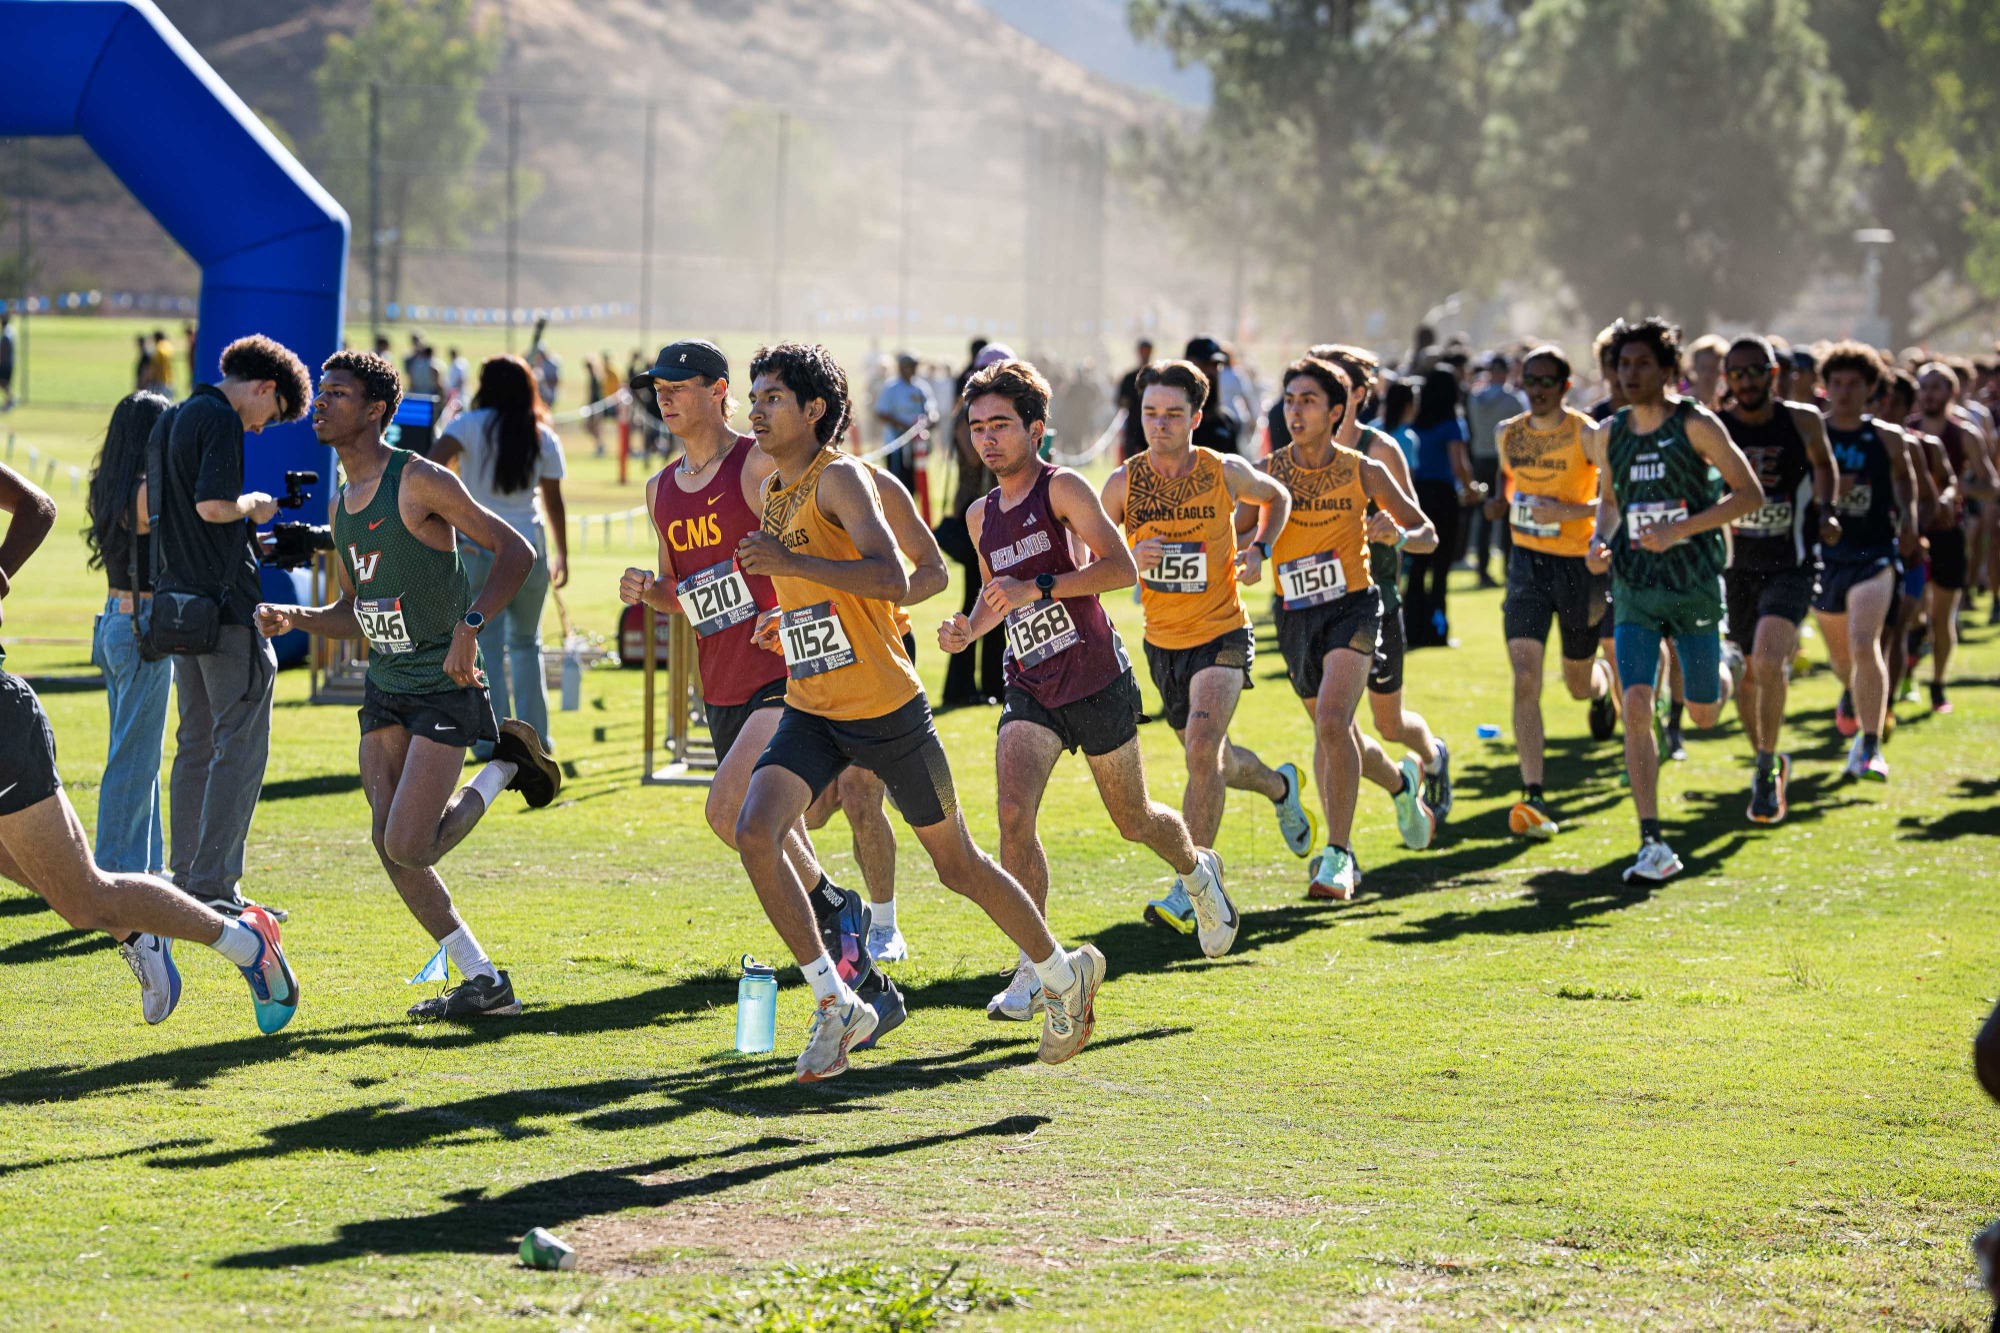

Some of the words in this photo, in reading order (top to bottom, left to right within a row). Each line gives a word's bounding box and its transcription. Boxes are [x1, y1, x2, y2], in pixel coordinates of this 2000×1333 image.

[1629, 462, 1665, 482] HILLS
[1176, 506, 1216, 520] EAGLES
[1314, 497, 1353, 511] EAGLES
[667, 512, 722, 552] CMS
[1173, 522, 1205, 538] COUNTRY
[347, 543, 382, 584] LV
[989, 530, 1051, 572] REDLANDS
[688, 576, 742, 621] 1210
[1289, 563, 1337, 597] 1150
[787, 620, 840, 661] 1152
[1011, 604, 1070, 655] 1368
